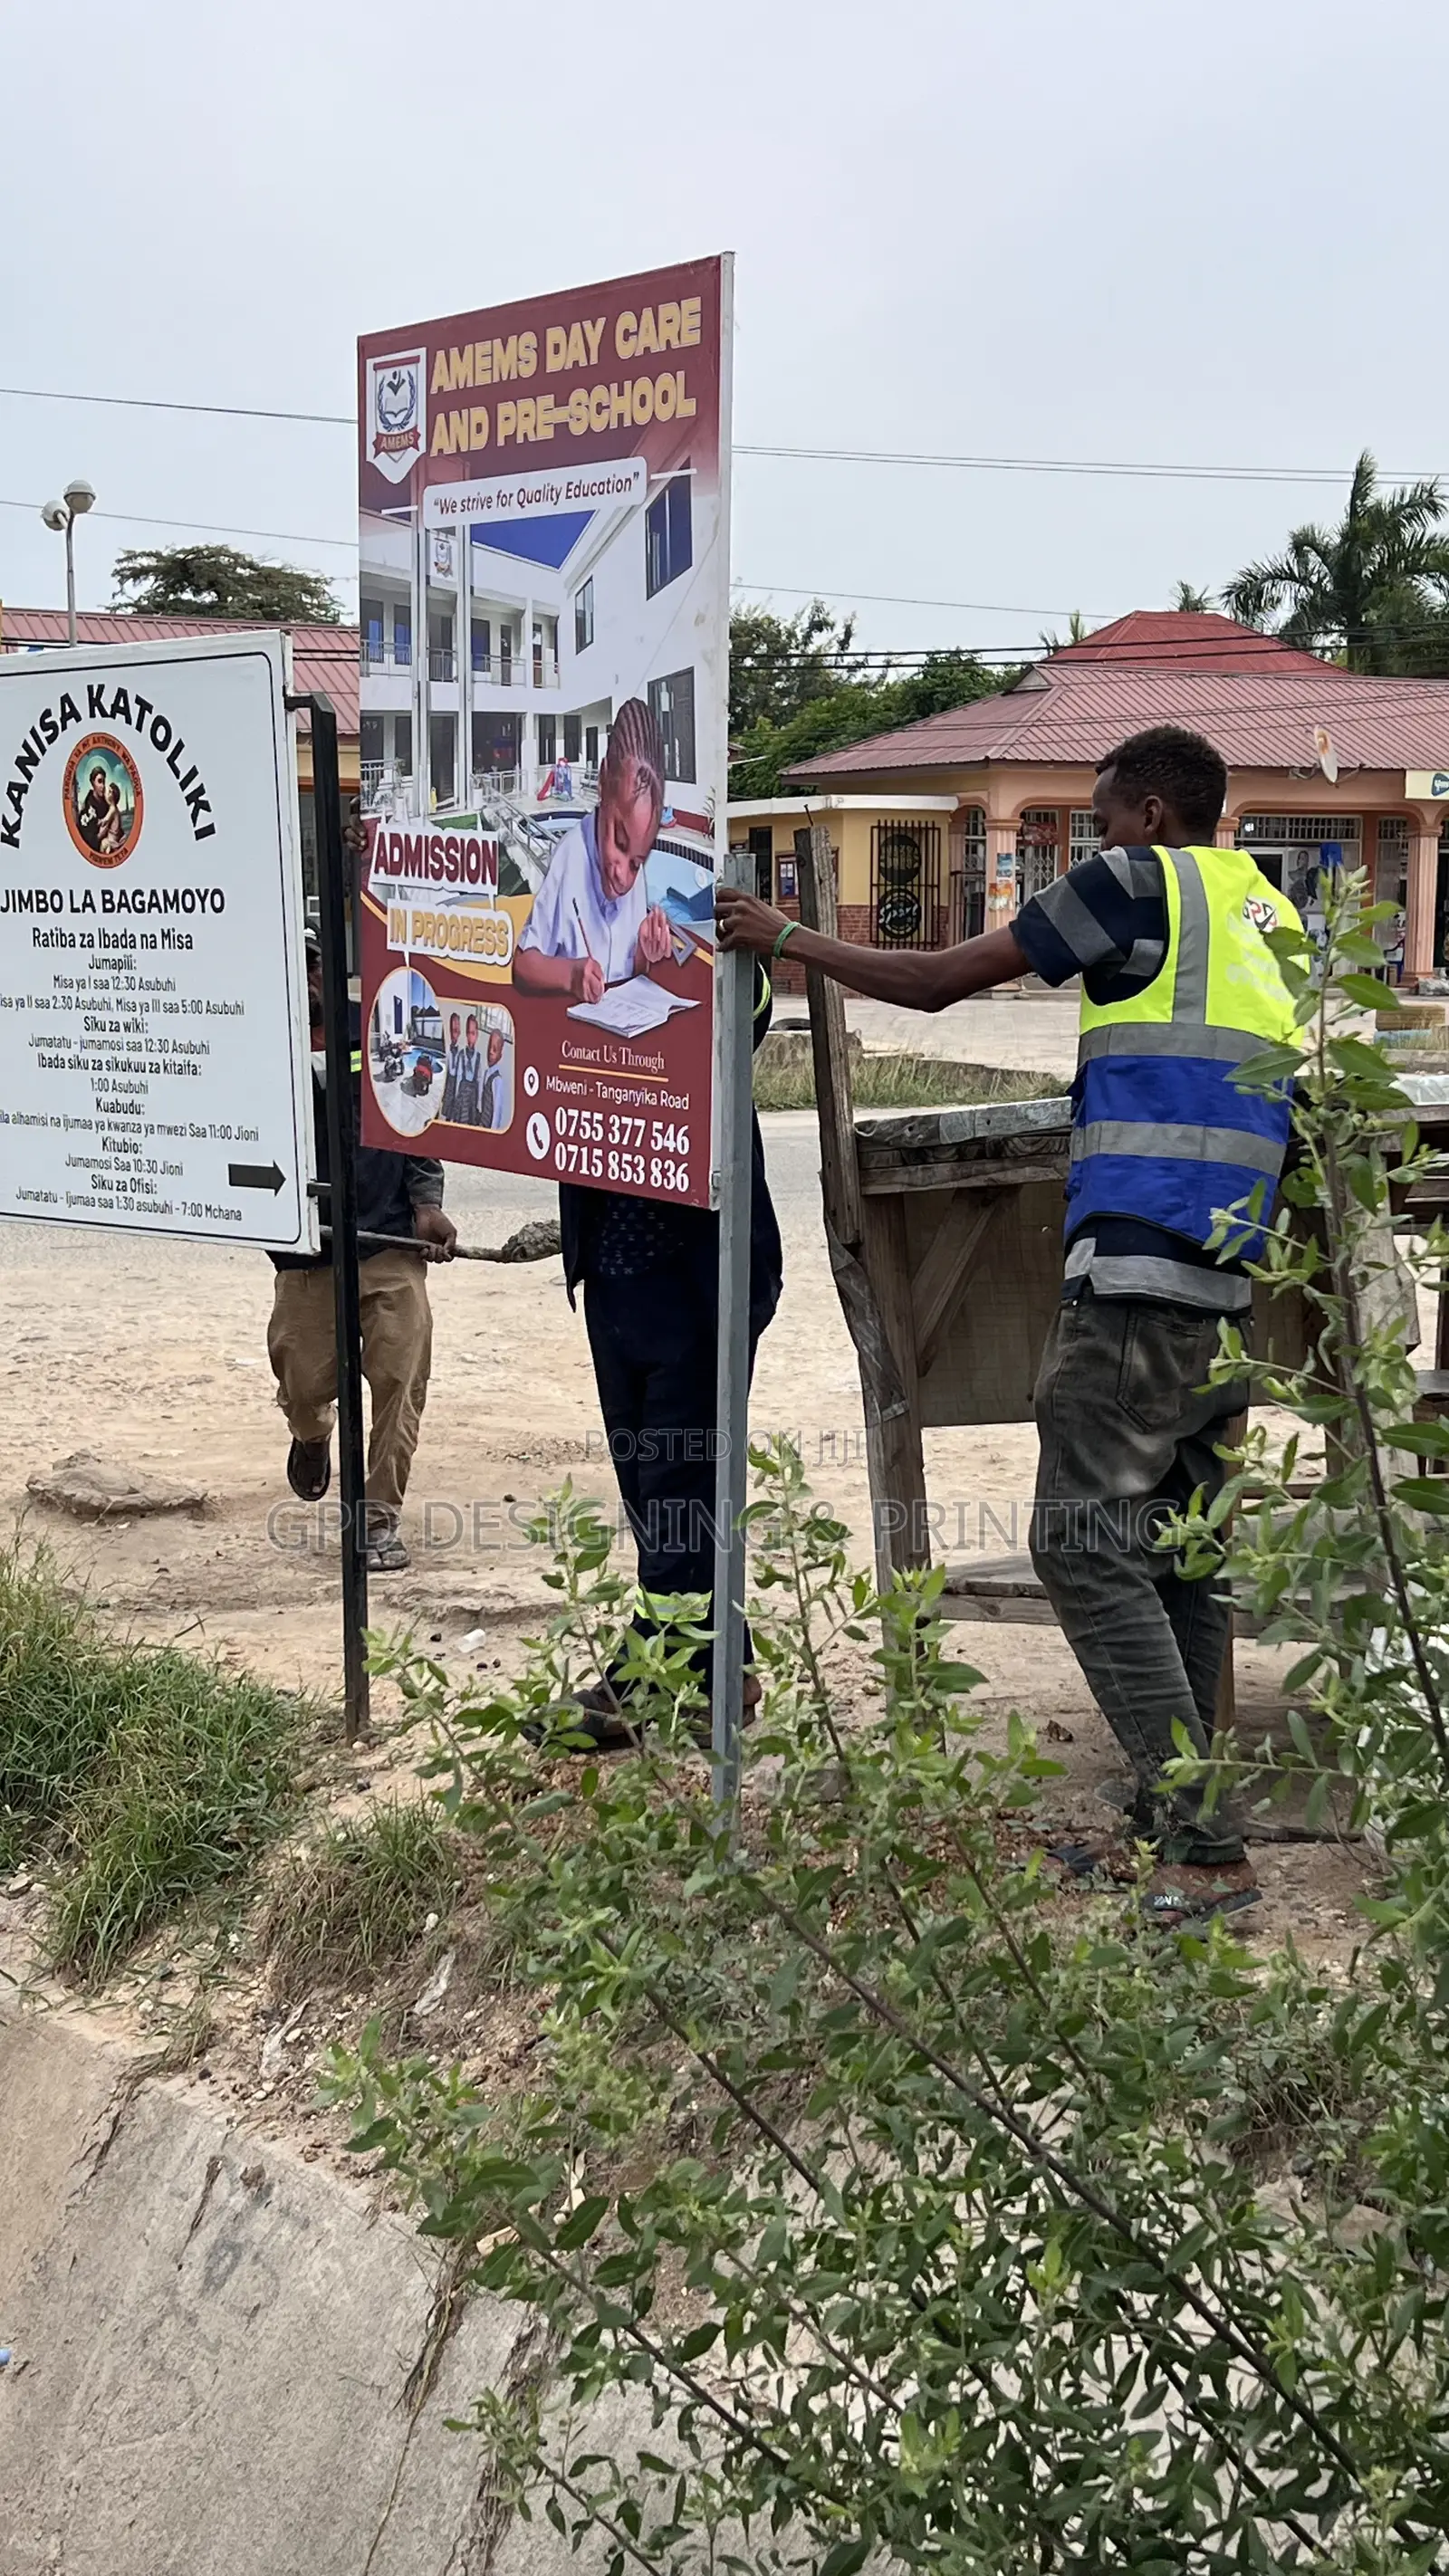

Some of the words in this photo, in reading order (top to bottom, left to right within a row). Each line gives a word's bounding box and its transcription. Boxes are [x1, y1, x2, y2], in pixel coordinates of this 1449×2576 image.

[430, 331, 538, 394] AMEMS
[546, 317, 606, 373] DAY
[615, 296, 701, 359] CARE
[430, 406, 489, 456] AND
[496, 370, 696, 446] PRE-SCHOOL
[380, 431, 415, 450] AMEMS
[460, 492, 494, 513] strive
[496, 491, 513, 507] for
[516, 482, 562, 506] Quality
[1, 693, 82, 848] KANISA
[87, 684, 216, 841] KATOLIKI
[373, 831, 498, 886] ADMISSION
[1, 889, 62, 913] JIMBO
[69, 890, 97, 913] LA
[101, 888, 226, 914] BAGAMOYO
[33, 927, 76, 949] Ratiba
[79, 934, 95, 949] za
[98, 928, 137, 950] Ibada
[140, 934, 157, 950] na
[160, 929, 194, 950] Misa
[389, 908, 408, 945] IN
[411, 912, 510, 957] PROGRESS
[88, 954, 137, 973] Jumapili:
[53, 975, 73, 989] Misa
[76, 978, 86, 992] ya
[93, 979, 110, 990] saa
[111, 976, 136, 991] 12:30
[139, 977, 176, 991] Asubuhi
[14, 998, 25, 1011] ya
[34, 998, 50, 1010] saa
[116, 997, 137, 1011] Misa
[139, 1001, 149, 1014] ya
[163, 1002, 179, 1013] saa
[181, 999, 203, 1014] 5:00
[206, 1000, 245, 1015] Asubuhi
[84, 1017, 106, 1032] Siku
[109, 1020, 120, 1032] za
[122, 1018, 149, 1034] wiki:
[29, 1033, 72, 1049] Jumatatu
[80, 1035, 124, 1053] jumamosi
[126, 1041, 142, 1052] saa
[144, 1038, 168, 1054] 12:30
[171, 1039, 210, 1055] Asubuhi
[38, 1052, 65, 1068] Ibada
[68, 1054, 89, 1070] siku
[91, 1059, 102, 1071] za
[105, 1056, 146, 1073] sikukuu
[149, 1061, 160, 1074] za
[163, 1058, 202, 1076] kitaifa:
[561, 1040, 601, 1063] Contact
[603, 1045, 617, 1064] Us
[619, 1050, 665, 1074] Through
[91, 1077, 110, 1093] 1:00
[111, 1079, 149, 1094] Asubuhi
[545, 1076, 587, 1096] Mbweni
[596, 1081, 657, 1106] Tanganyika
[660, 1087, 689, 1110] Road
[96, 1097, 145, 1116] Kuabudu:
[12, 1112, 48, 1126] alhamisi
[51, 1116, 61, 1127] na
[95, 1120, 105, 1133] ya
[107, 1118, 141, 1134] kwanza
[144, 1124, 155, 1137] ya
[158, 1123, 187, 1136] mwezi
[188, 1123, 206, 1138] Saa
[209, 1124, 232, 1140] 11:00
[235, 1125, 259, 1141] Jioni
[555, 1106, 604, 1141] 0755
[609, 1114, 646, 1147] 377
[650, 1122, 689, 1155] 546
[102, 1137, 142, 1154] Kitubio:
[65, 1154, 111, 1170] Jumamosi
[114, 1157, 131, 1172] Saa
[133, 1158, 158, 1173] 10:30
[160, 1161, 183, 1176] Jioni
[555, 1141, 602, 1176] 0715
[608, 1148, 646, 1184] 853
[650, 1156, 689, 1192] 836
[91, 1174, 113, 1191] Siku
[116, 1180, 128, 1192] za
[130, 1177, 158, 1194] Ofisi:
[16, 1186, 58, 1203] Jumatatu
[98, 1197, 114, 1209] saa
[116, 1195, 134, 1211] 1:30
[137, 1199, 173, 1214] asubuhi
[181, 1202, 203, 1217] 7:00
[206, 1203, 242, 1221] Mchana
